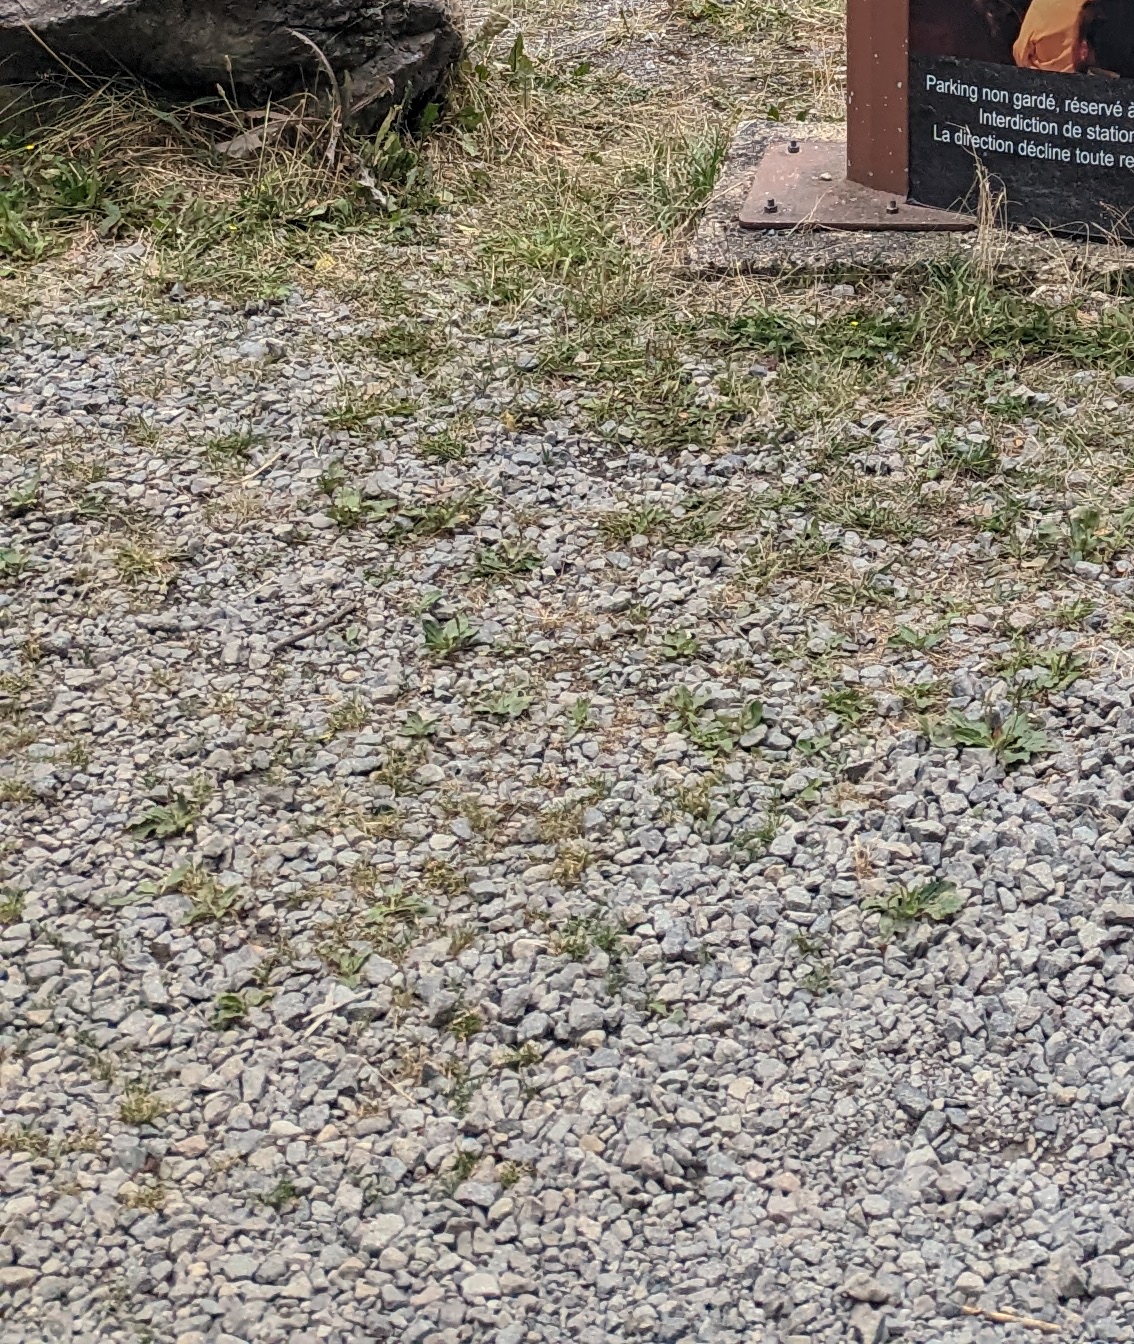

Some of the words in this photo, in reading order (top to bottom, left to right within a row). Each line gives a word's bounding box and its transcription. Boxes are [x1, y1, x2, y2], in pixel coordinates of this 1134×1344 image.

[925, 74, 978, 102] Parking
[982, 86, 1009, 104] non
[1013, 92, 1060, 113] gardé,
[1064, 96, 1123, 118] réservé
[978, 108, 1058, 136] Interdiction
[1062, 121, 1082, 139] de
[933, 124, 951, 143] La
[954, 129, 1014, 154] direction
[1017, 139, 1071, 162] décline
[1075, 148, 1115, 167] toute
